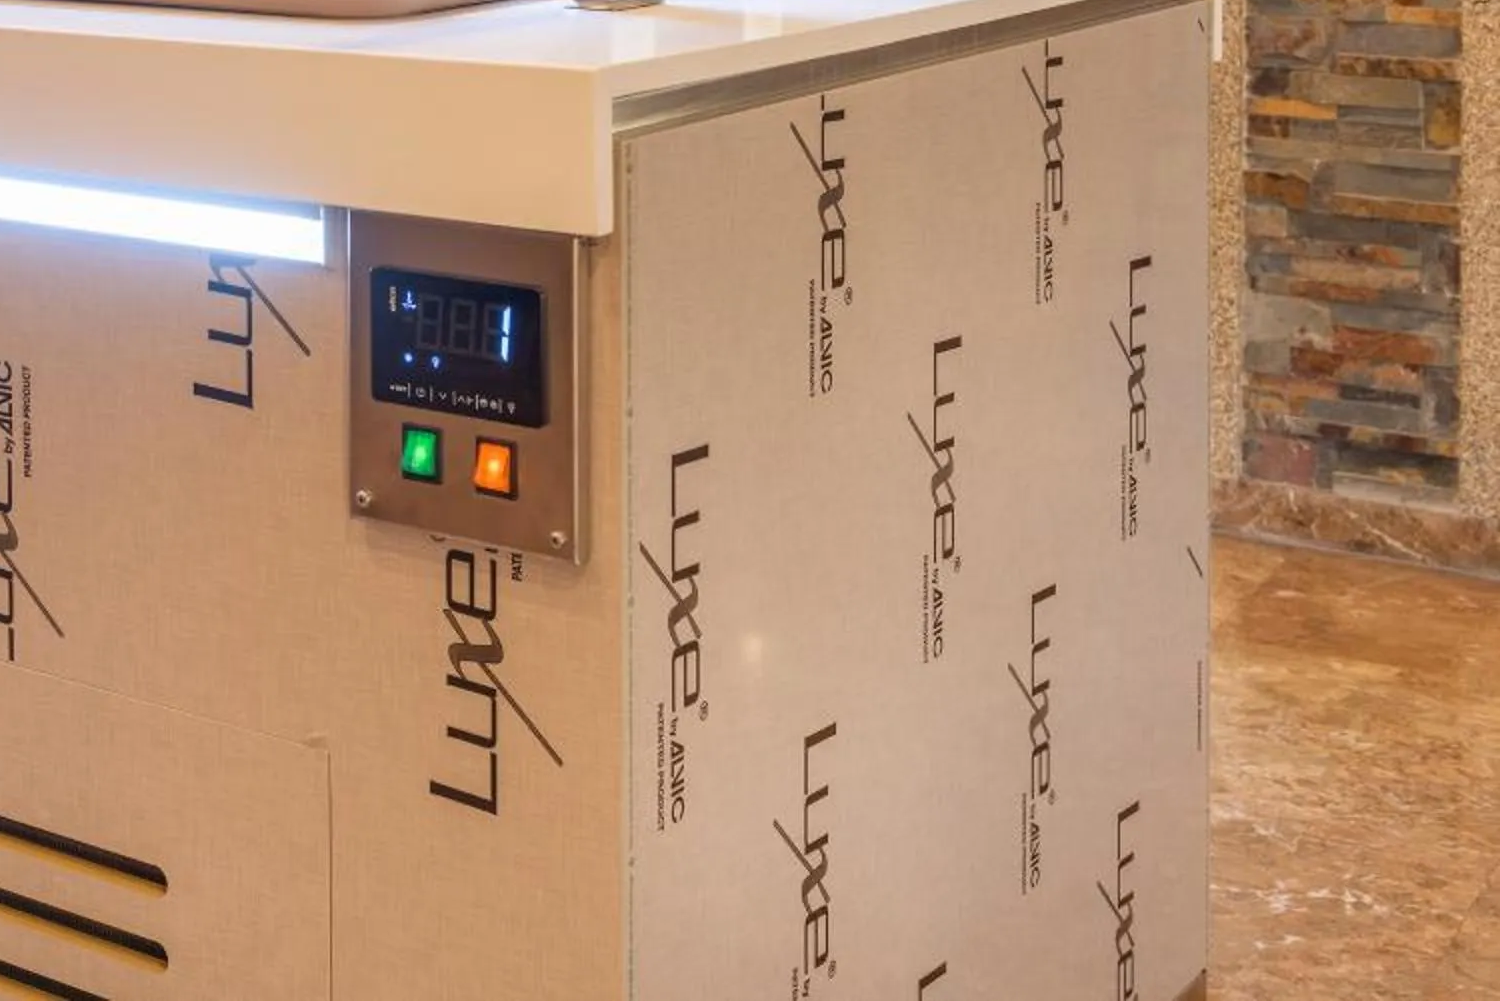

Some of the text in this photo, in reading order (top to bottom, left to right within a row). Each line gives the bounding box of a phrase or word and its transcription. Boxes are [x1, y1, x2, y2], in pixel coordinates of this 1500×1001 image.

[4, 437, 16, 454] by
[21, 365, 32, 478] PATENTED PRODUCT
[820, 316, 833, 395] ALVIC
[907, 336, 963, 563] Luxe
[1109, 255, 1152, 454] Luxe
[639, 444, 709, 712] Luxe
[932, 587, 943, 659] ALVIC
[429, 549, 564, 816] Luxe
[670, 740, 685, 824] ALVIC
[1007, 584, 1057, 799] Luxe
[773, 722, 837, 975] Luxe
[1097, 800, 1140, 1001] Luxe
